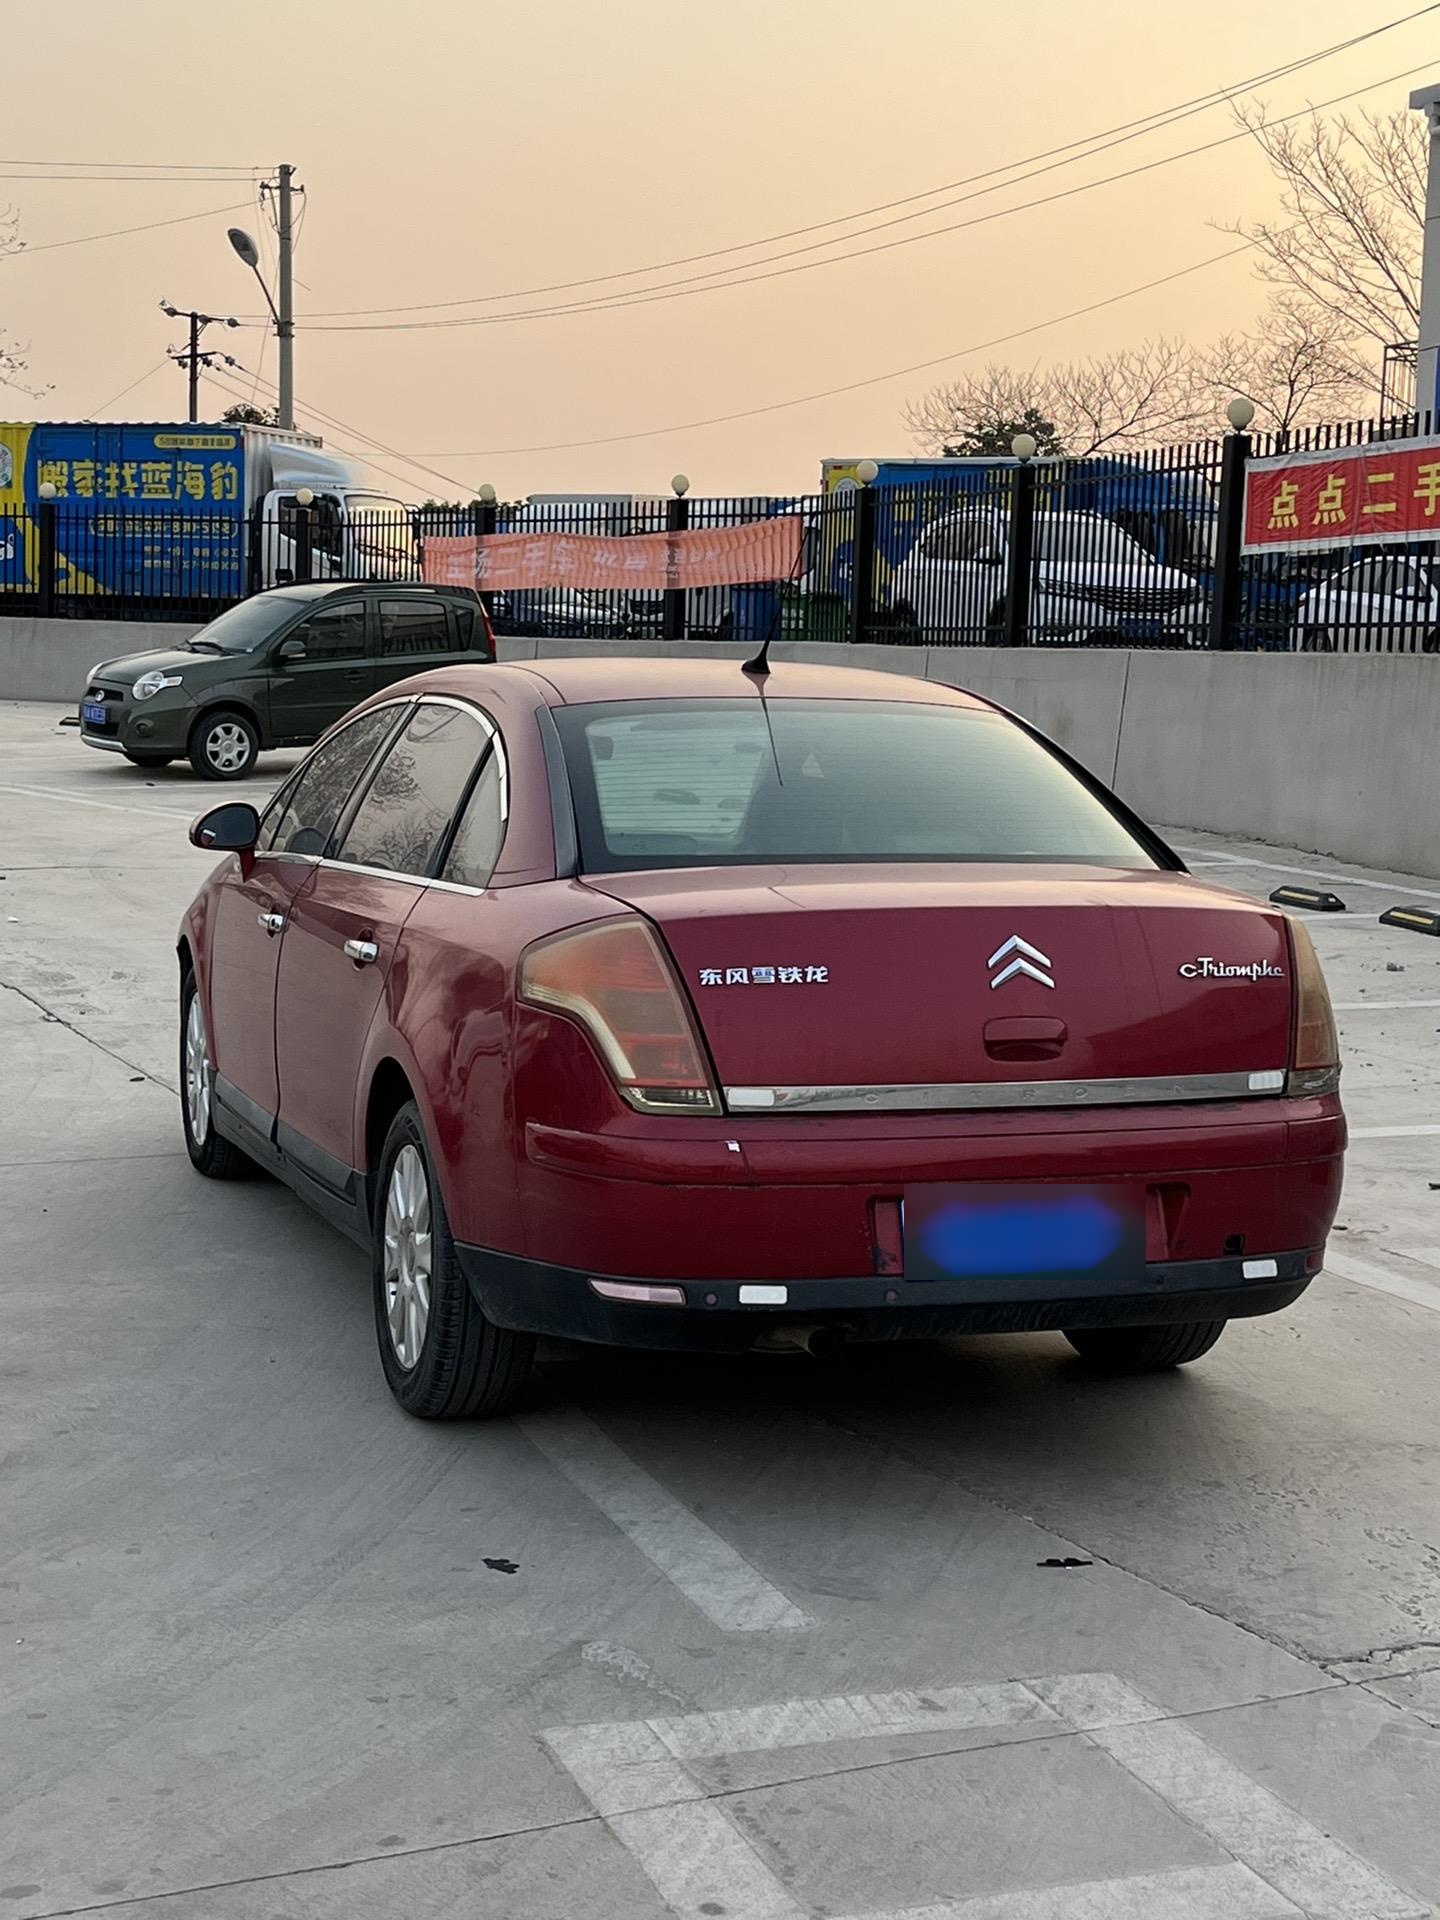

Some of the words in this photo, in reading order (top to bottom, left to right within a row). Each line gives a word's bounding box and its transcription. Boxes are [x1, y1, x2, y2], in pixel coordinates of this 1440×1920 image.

[37, 460, 238, 500] 搬家找蓝海豹
[699, 965, 829, 985] 东风雪铁龙
